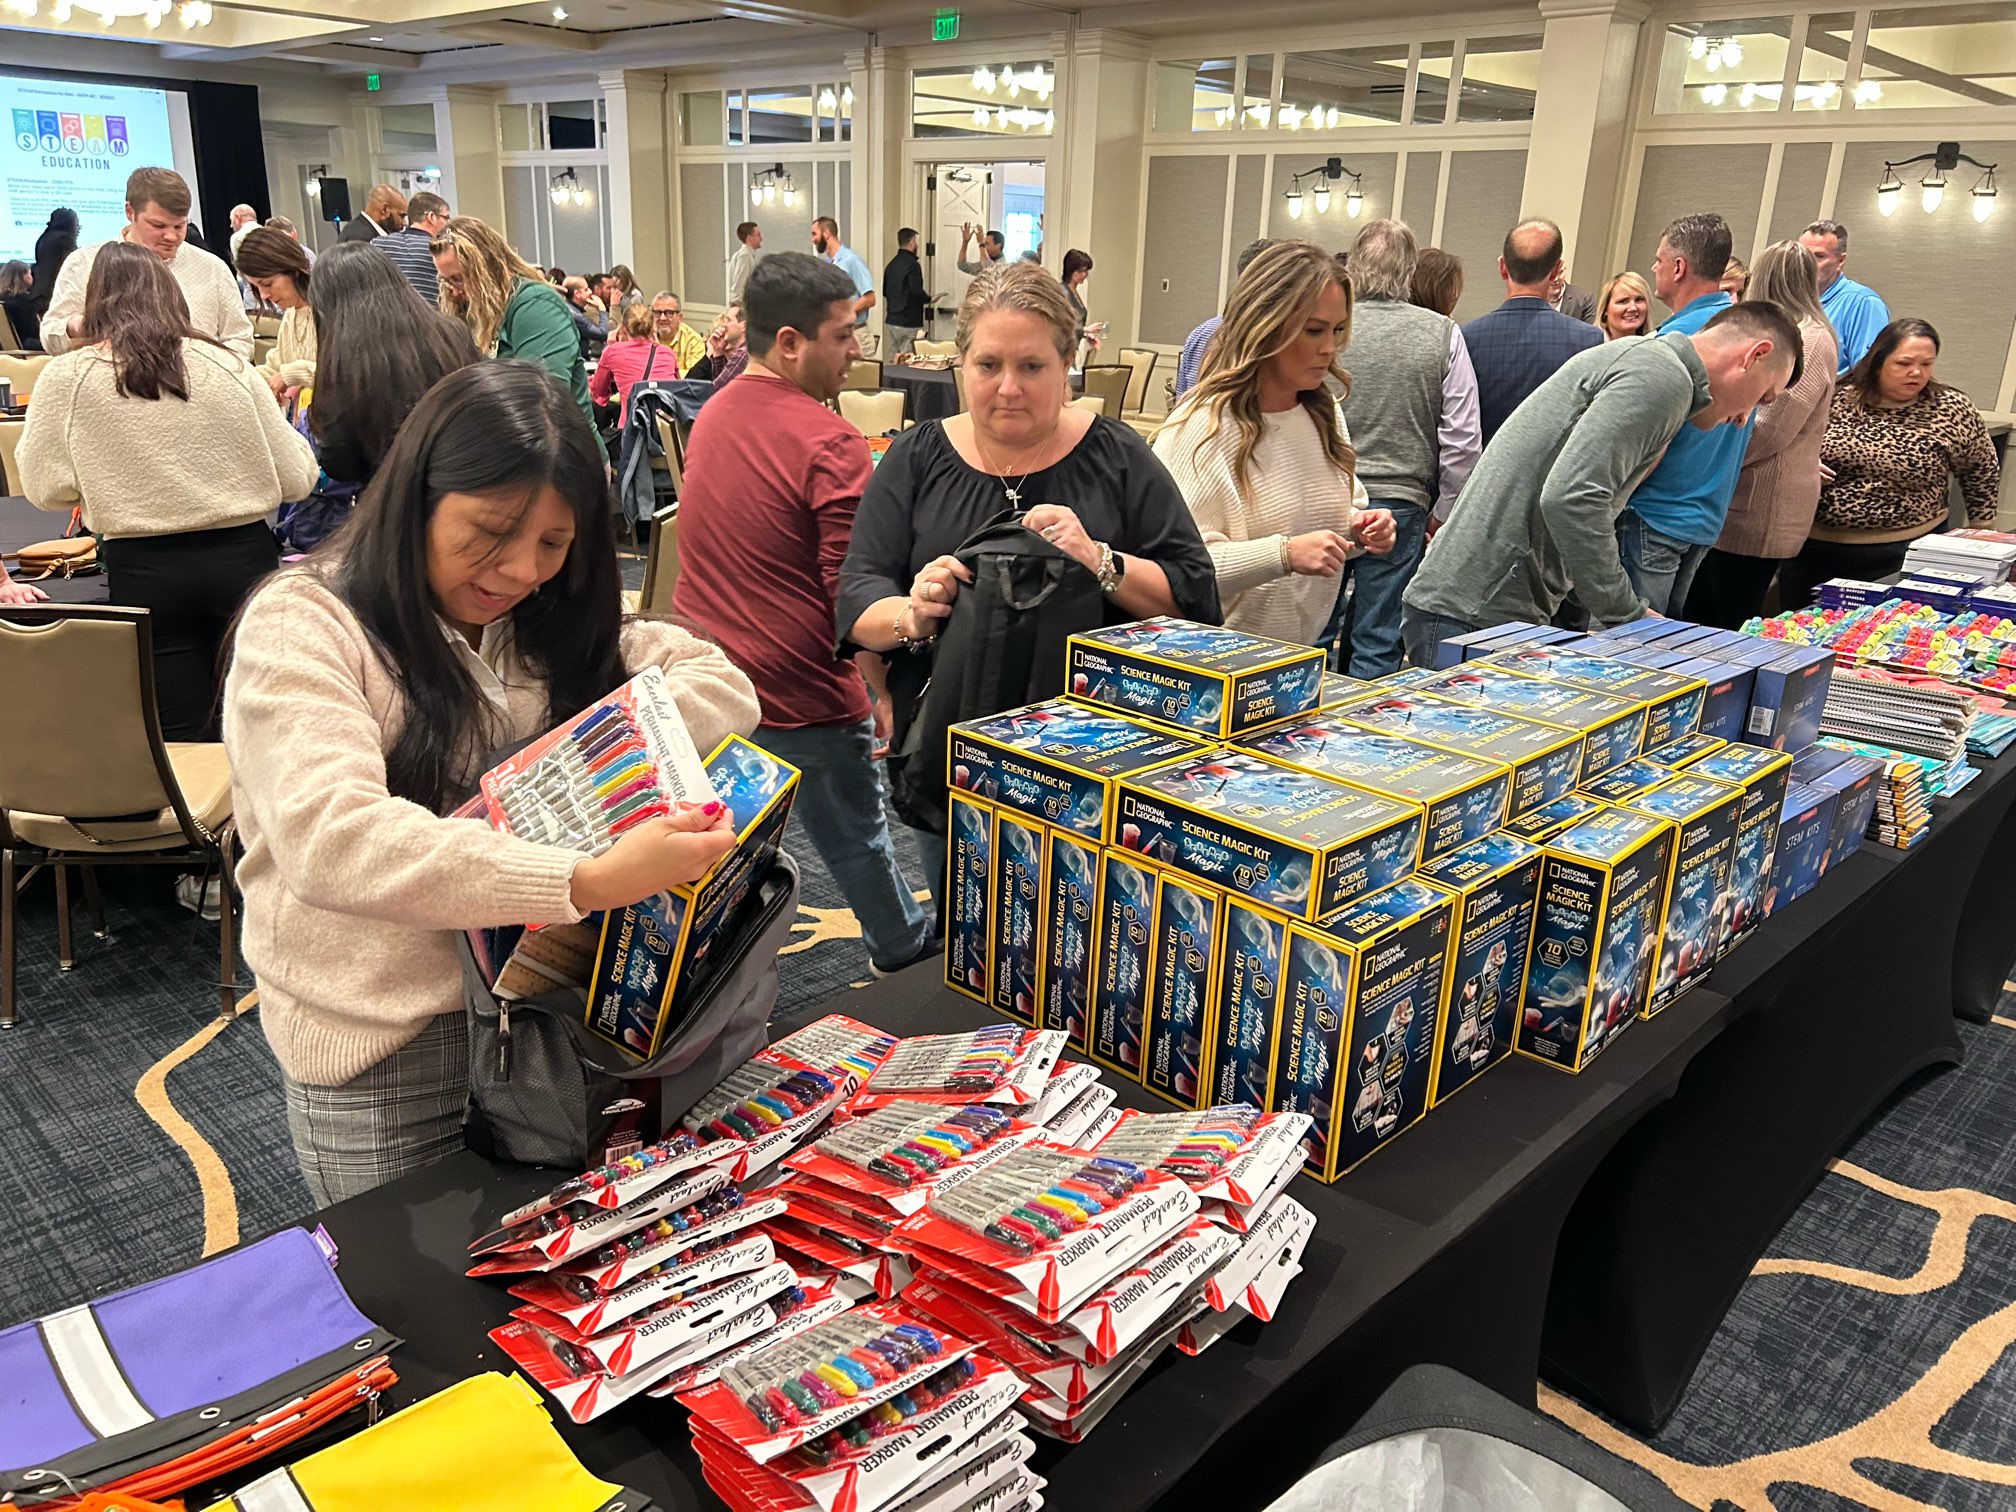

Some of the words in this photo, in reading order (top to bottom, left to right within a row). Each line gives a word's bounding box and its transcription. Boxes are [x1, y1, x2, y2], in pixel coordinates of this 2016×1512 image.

[936, 17, 956, 39] EXIT
[41, 155, 111, 171] EDUCATION
[1083, 660, 1115, 675] GEOGRAPHIC
[1084, 653, 1108, 666] NATIONAL
[1120, 665, 1152, 682] SCIENCE
[1152, 673, 1178, 689] MAGIC
[1177, 680, 1192, 693] KIT
[1246, 684, 1273, 697] GEOGRAPHIC
[1247, 679, 1267, 689] NATIONAL
[642, 674, 672, 721] Everlast
[1122, 691, 1157, 707] Magic
[1166, 700, 1175, 709] 10
[1248, 695, 1274, 711] SCIENCE
[1243, 707, 1267, 723] MAGIC
[1265, 705, 1277, 716] KIT
[639, 705, 671, 760] PERMANENT
[663, 759, 687, 801] MARKER
[964, 752, 996, 769] GEOGRAPHIC
[965, 746, 989, 759] NATIONAL
[1001, 760, 1033, 778] SCIENCE
[1033, 770, 1059, 787] MAGIC
[1058, 779, 1073, 793] KIT
[1004, 788, 1038, 805] Magic
[1048, 799, 1057, 810] 10
[1136, 802, 1166, 819] NATIONAL
[1841, 798, 1856, 815] STEM
[1857, 788, 1871, 804] KITS
[1135, 809, 1175, 830] GEOGRAPHIC
[1438, 820, 1464, 839] SCIENCE
[958, 837, 967, 854] KIT
[1181, 820, 1221, 842] SCIENCE
[1221, 834, 1253, 856] MAGIC
[1253, 847, 1272, 862] KIT
[1433, 833, 1455, 852] MAGIC
[1453, 830, 1464, 843] KIT
[1785, 832, 1803, 851] STEM
[1806, 821, 1821, 838] KITS
[957, 853, 966, 886] MAGIC
[973, 861, 980, 871] 10
[1005, 859, 1015, 875] KIT
[1184, 852, 1227, 873] Magic
[1337, 854, 1367, 871] GEOGRAPHIC
[1338, 849, 1361, 863] NATIONAL
[1681, 854, 1704, 874] SCIENCE
[1022, 882, 1029, 893] 10
[1058, 878, 1068, 895] KIT
[1239, 868, 1250, 878] 10
[1338, 867, 1368, 888] SCIENCE
[1560, 872, 1598, 888] GEOGRAPHIC
[1562, 866, 1590, 880] NATIONAL
[955, 886, 964, 923] SCIENCE
[1004, 874, 1014, 907] MAGIC
[1333, 880, 1358, 902] MAGIC
[1356, 878, 1370, 891] KIT
[1546, 892, 1579, 910] MAGIC
[1578, 899, 1594, 913] KIT
[1551, 883, 1591, 900] SCIENCE
[623, 905, 637, 926] KIT
[973, 885, 983, 927] Magic
[1056, 895, 1066, 929] MAGIC
[1075, 903, 1082, 914] 10
[1112, 900, 1122, 919] KIT
[617, 923, 634, 950] MAGIC
[1003, 907, 1012, 946] SCIENCE
[1021, 907, 1032, 950] Magic
[1109, 918, 1120, 951] MAGIC
[1130, 926, 1138, 938] 10
[1168, 925, 1179, 945] KIT
[1463, 920, 1489, 944] SCIENCE
[1488, 909, 1509, 929] MAGIC
[1506, 904, 1519, 918] KIT
[1546, 914, 1586, 931] Magic
[648, 935, 659, 947] 10
[1054, 929, 1063, 968] SCIENCE
[1074, 929, 1085, 973] Magic
[1376, 943, 1402, 962] NATIONAL
[1547, 942, 1562, 956] 10
[611, 948, 629, 985] SCIENCE
[1106, 951, 1118, 993] SCIENCE
[1165, 944, 1177, 978] MAGIC
[1188, 953, 1196, 965] 10
[1235, 949, 1246, 970] KIT
[1374, 948, 1408, 973] GEOGRAPHIC
[640, 959, 657, 997] Magic
[1128, 953, 1141, 998] Magic
[1231, 970, 1244, 1004] MAGIC
[1255, 978, 1264, 991] 10
[1360, 978, 1391, 1004] SCIENCE
[1391, 964, 1416, 986] MAGIC
[1413, 957, 1427, 973] KIT
[1055, 975, 1063, 1017] GEOGRAPHIC
[1161, 978, 1174, 1021] SCIENCE
[1185, 981, 1199, 1027] Magic
[1296, 980, 1308, 1001] KIT
[600, 994, 613, 1020] NATIONAL
[608, 990, 622, 1025] GEOGRAPHIC
[1107, 999, 1117, 1043] GEOGRAPHIC
[1291, 1001, 1306, 1037] MAGIC
[1318, 1011, 1328, 1023] 10
[1101, 1008, 1110, 1039] NATIONAL
[1227, 1004, 1240, 1048] SCIENCE
[1251, 1007, 1266, 1055] Magic
[1155, 1037, 1165, 1070] NATIONAL
[1161, 1027, 1172, 1073] GEOGRAPHIC
[1287, 1036, 1301, 1082] SCIENCE
[1227, 1055, 1238, 1101] GEOGRAPHIC
[1314, 1040, 1329, 1090] Magic
[843, 1075, 859, 1097] 10
[1220, 1064, 1230, 1097] NATIONAL
[750, 1131, 787, 1155] MARKER
[970, 1138, 1020, 1170] PERMANENT
[933, 1167, 973, 1193] MARKER
[624, 1180, 689, 1211] PERMANENT
[578, 1207, 627, 1232] MARKER
[1102, 1194, 1156, 1240] PERMANENT
[1141, 1190, 1190, 1234] Everlast
[1266, 1202, 1300, 1242] Everlast
[665, 1248, 732, 1281] PERMANENT
[710, 1243, 768, 1272] Everlast
[1055, 1232, 1101, 1268] MARKER
[1149, 1240, 1198, 1287] PERMANENT
[1187, 1235, 1231, 1276] Everlast
[613, 1279, 661, 1303] MARKER
[691, 1276, 755, 1314] PERMANENT
[736, 1268, 790, 1305] Everlast
[1109, 1279, 1151, 1315] MARKER
[636, 1309, 688, 1338] MARKER
[707, 1307, 766, 1345] Everlast
[866, 1365, 938, 1407] PERMANENT
[805, 1405, 861, 1437] MARKER
[915, 1389, 981, 1439] PERMANENT
[962, 1383, 1019, 1430] Everlast
[858, 1433, 913, 1474] MARKER
[964, 1439, 1023, 1486] Everlast
